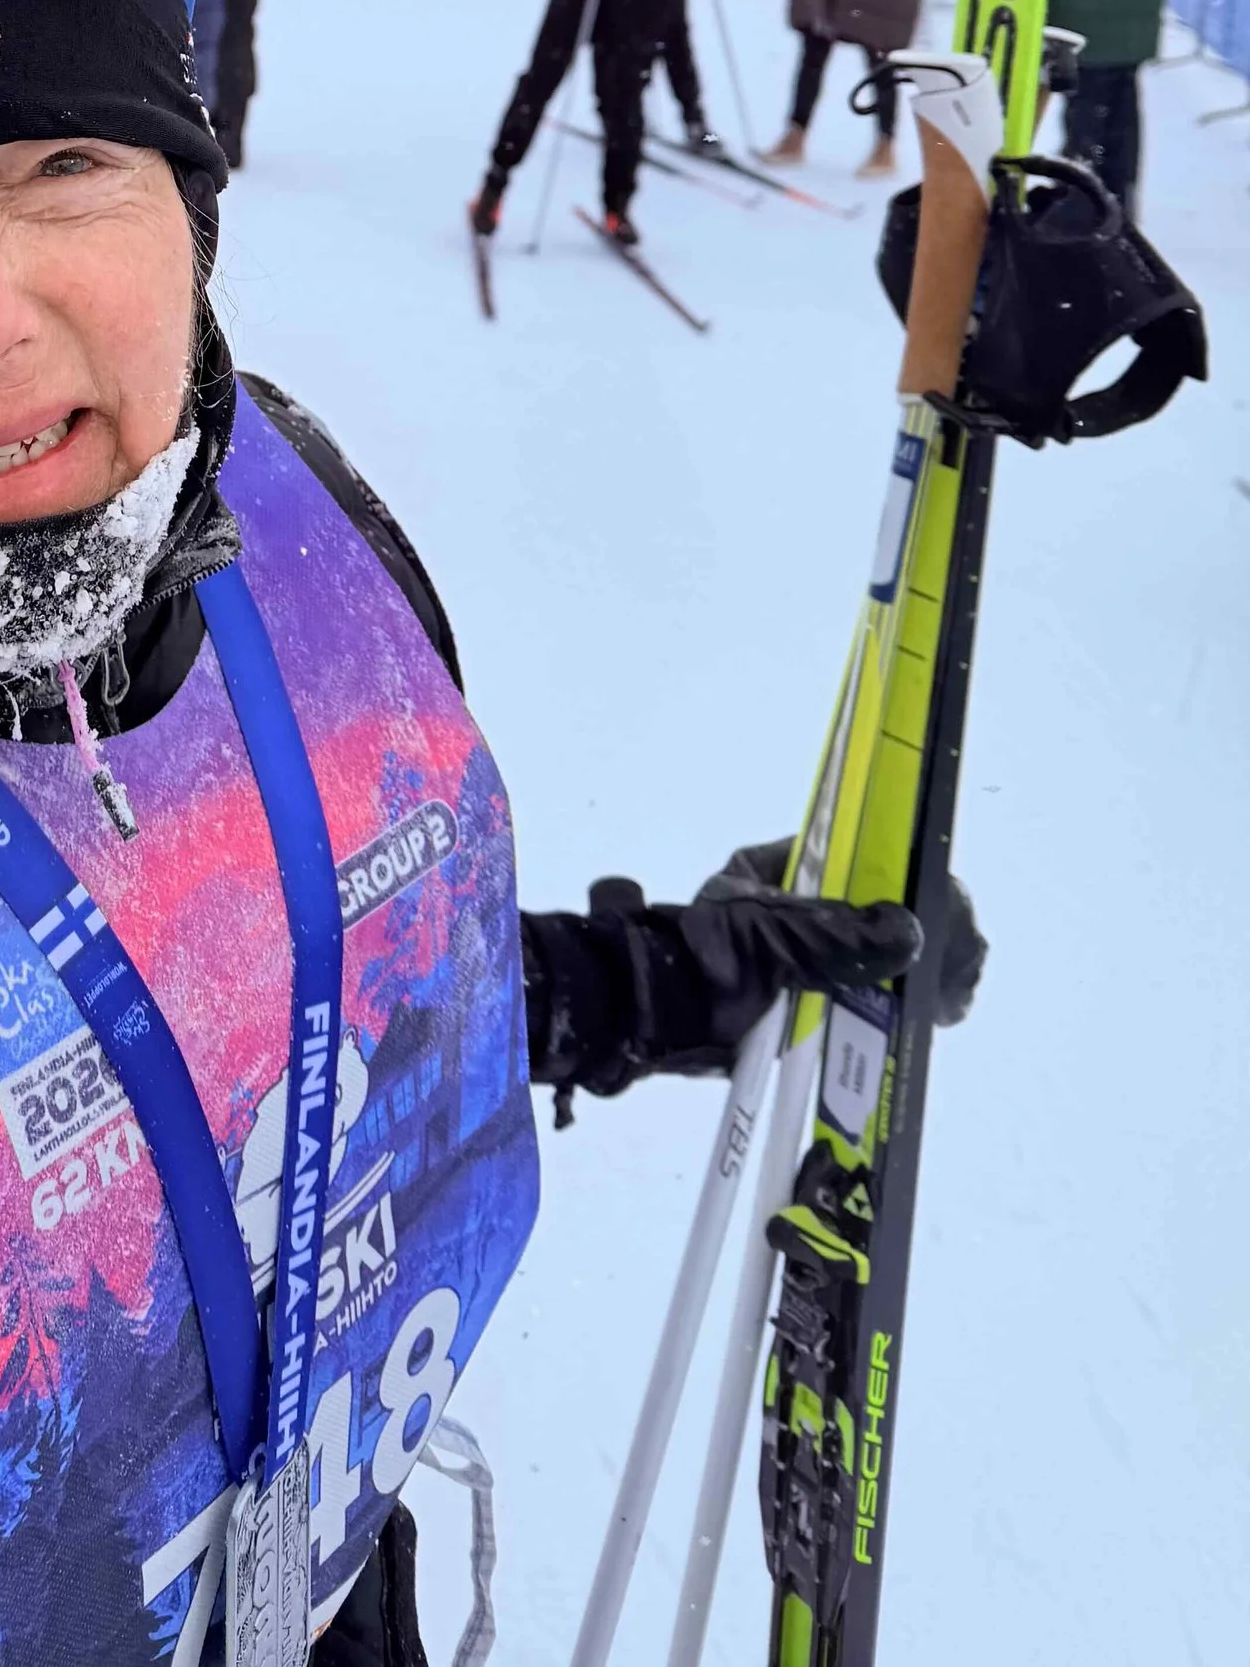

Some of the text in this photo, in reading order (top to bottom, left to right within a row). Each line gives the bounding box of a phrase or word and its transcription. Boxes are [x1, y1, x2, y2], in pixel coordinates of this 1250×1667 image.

[339, 814, 452, 914] GROUP 2
[30, 1161, 96, 1230] 62
[276, 1001, 330, 1464] FINLANDIA-HIIH
[313, 1260, 398, 1358] A-HIIHTO
[316, 1191, 397, 1321] SKI
[854, 1330, 892, 1564] FISCHER
